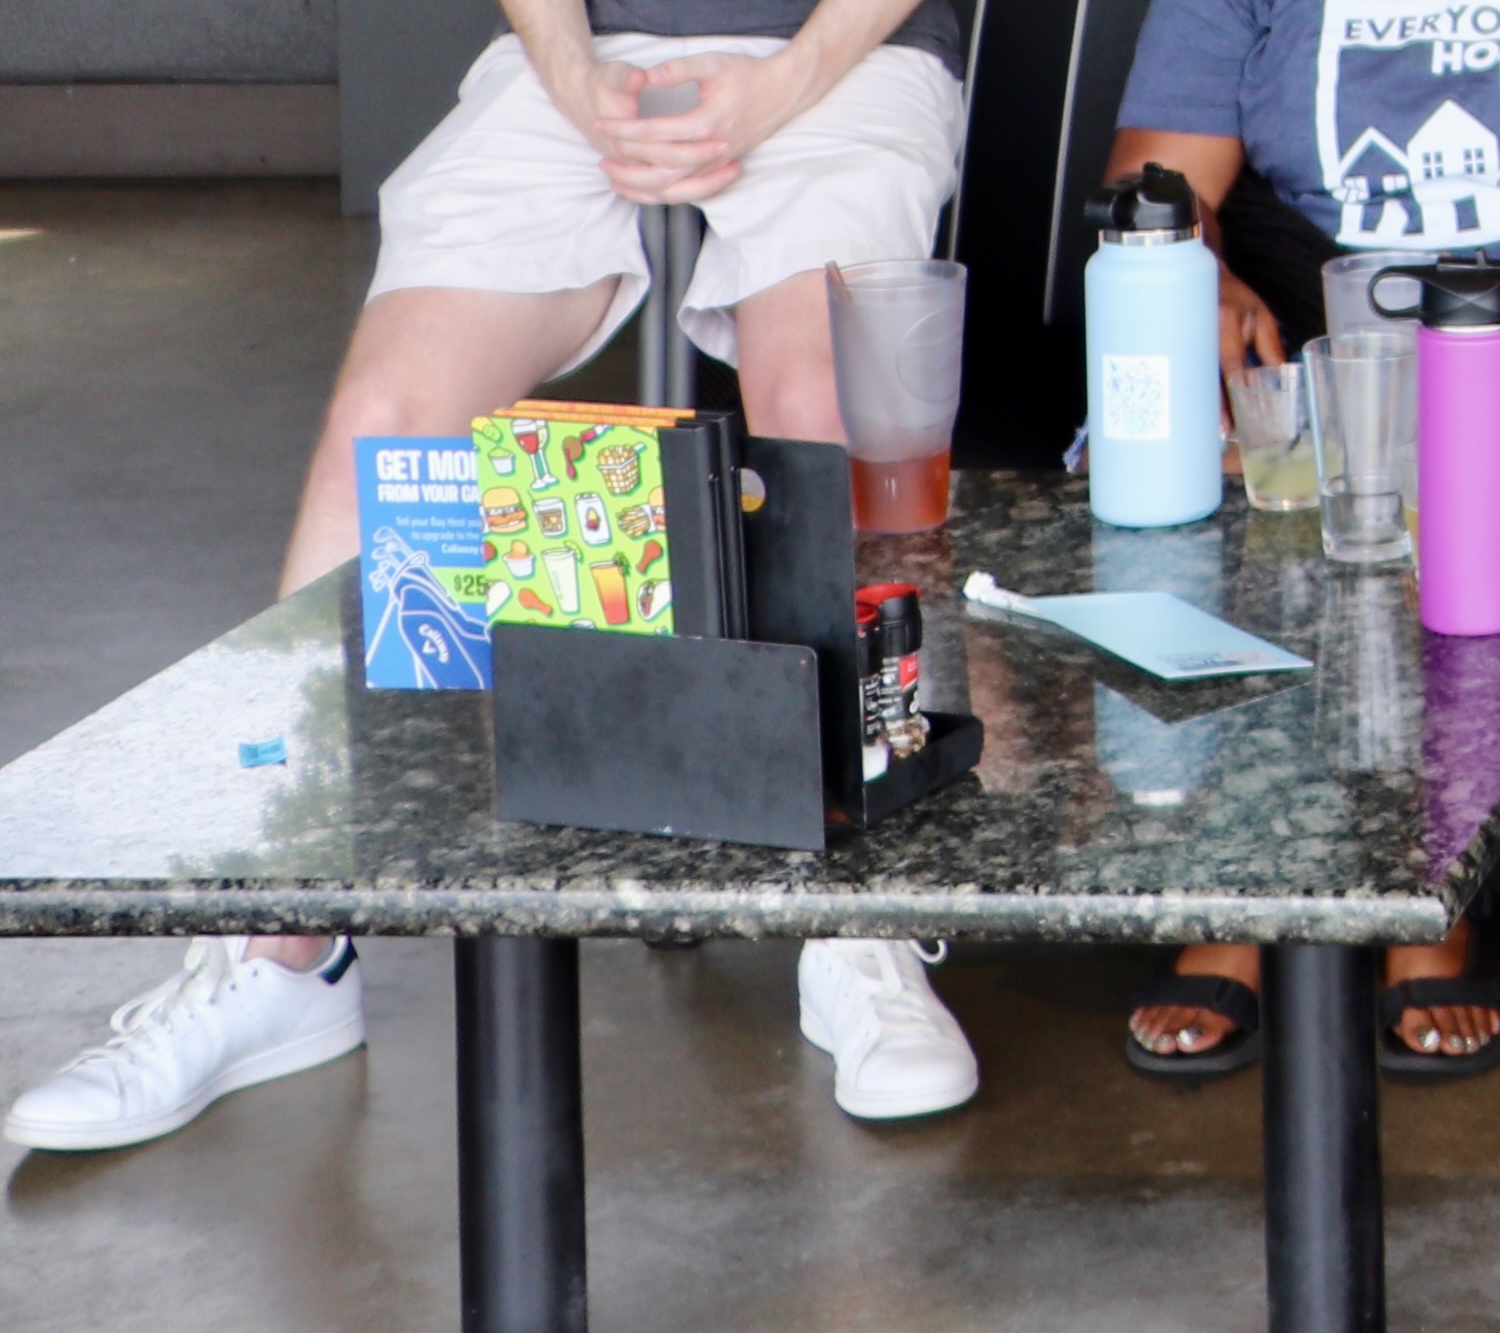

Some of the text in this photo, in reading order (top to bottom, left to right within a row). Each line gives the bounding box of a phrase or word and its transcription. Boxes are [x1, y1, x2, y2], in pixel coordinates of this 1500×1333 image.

[376, 449, 422, 481] GET
[378, 484, 419, 502] FROM
[421, 485, 459, 503] YOUR
